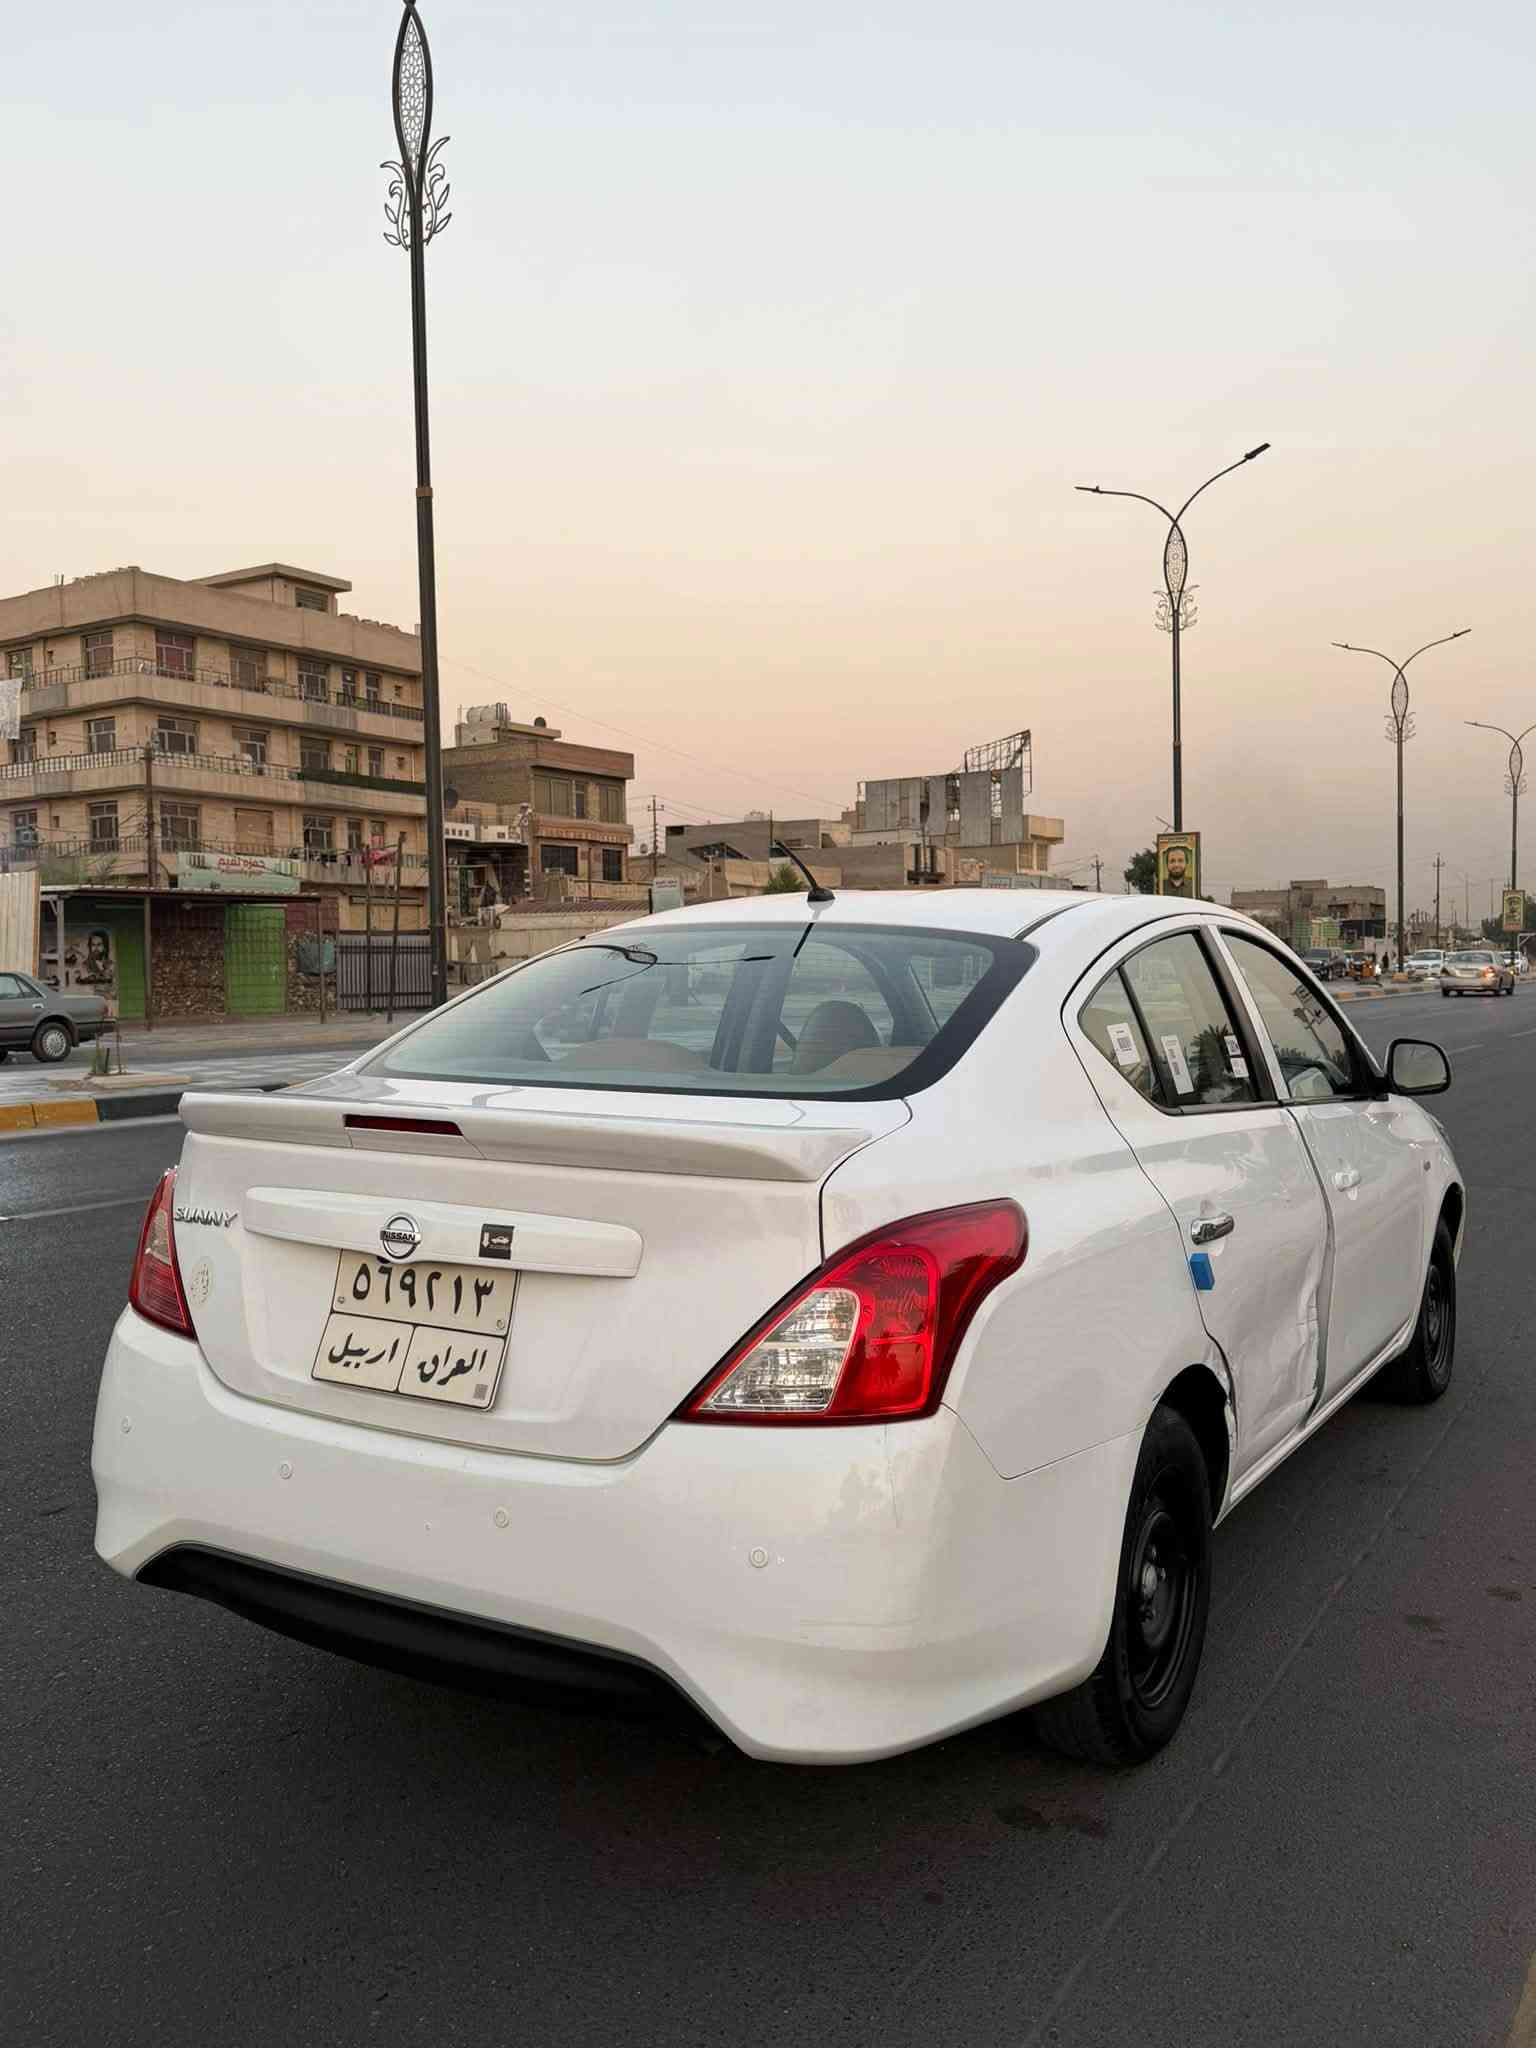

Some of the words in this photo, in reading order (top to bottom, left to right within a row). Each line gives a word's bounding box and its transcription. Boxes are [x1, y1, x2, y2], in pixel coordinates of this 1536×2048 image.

[174, 1206, 238, 1228] SUNNY
[384, 1231, 416, 1242] NISSAN
[352, 1263, 494, 1317] ٥٦٩٢١٣
[328, 1333, 400, 1369] اربيل
